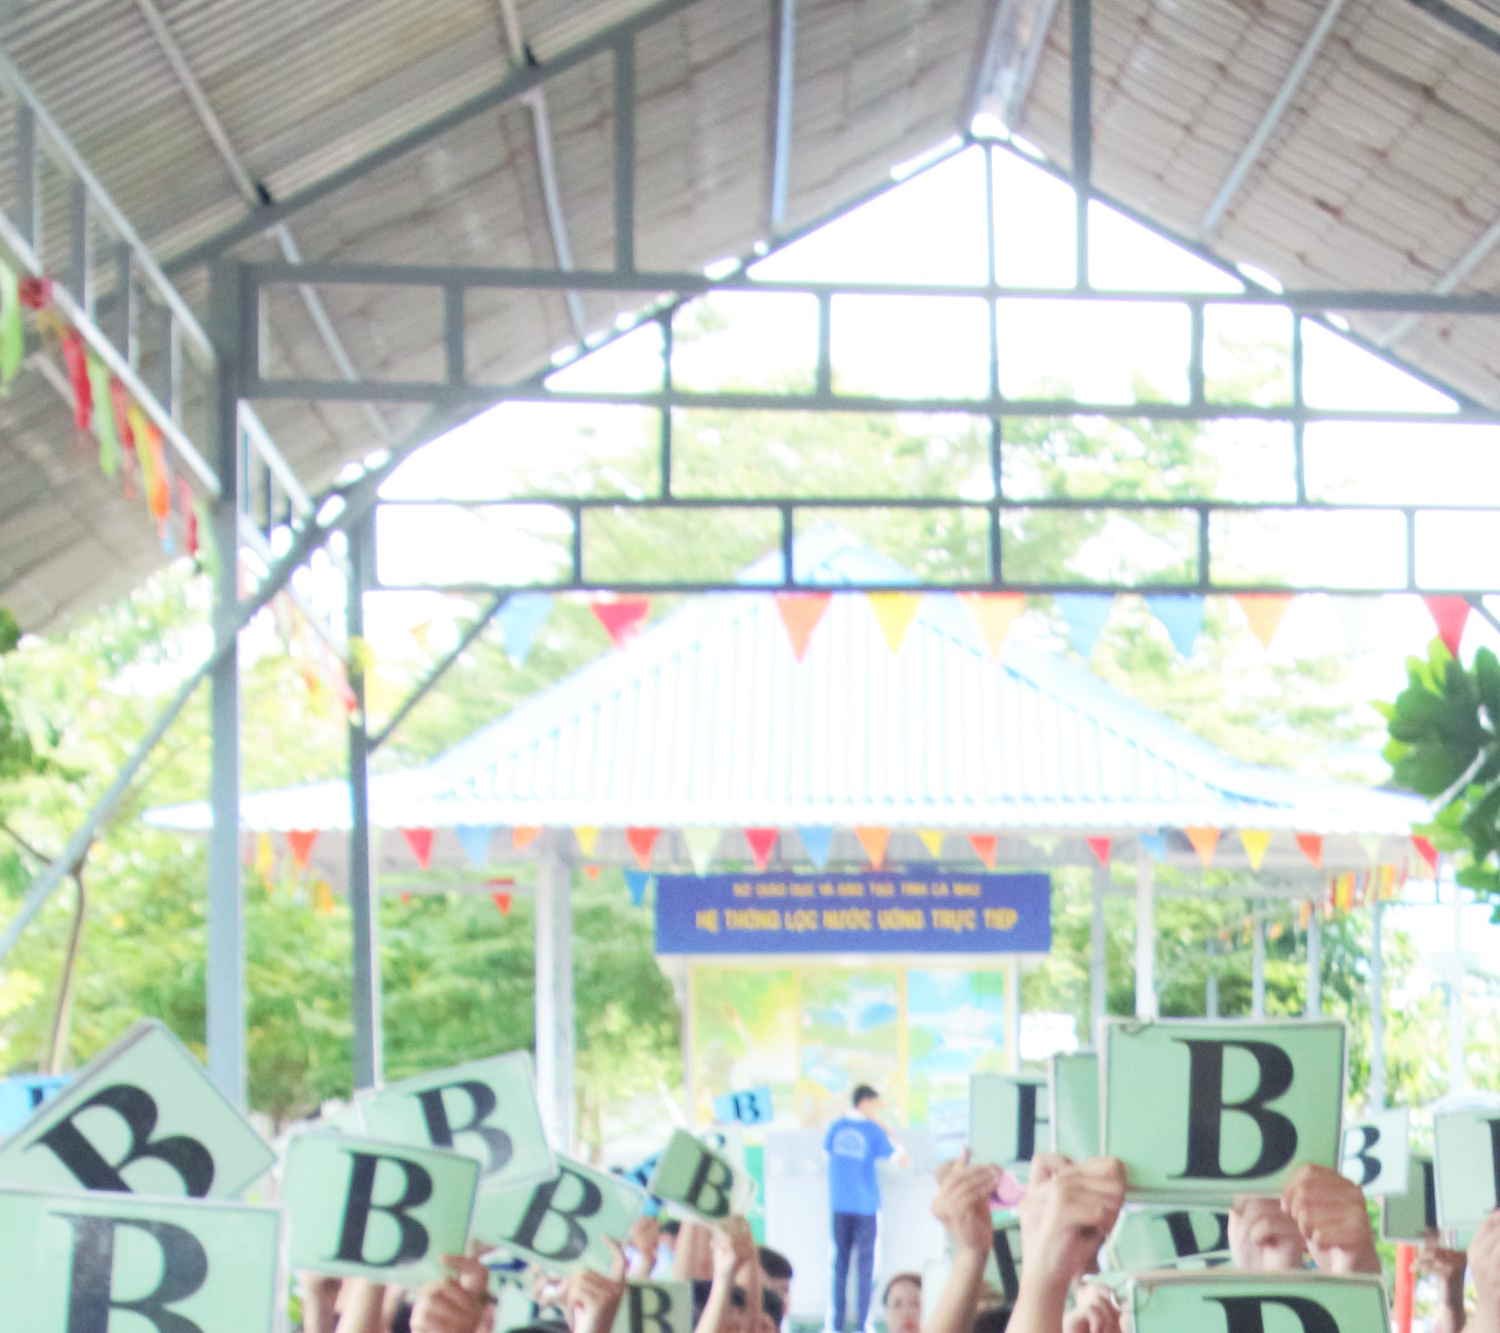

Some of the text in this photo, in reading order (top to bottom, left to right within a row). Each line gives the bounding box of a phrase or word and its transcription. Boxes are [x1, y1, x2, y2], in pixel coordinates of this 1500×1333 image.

[25, 1083, 214, 1198] B
[409, 1080, 514, 1178] B
[1167, 1037, 1298, 1180] B
[325, 1149, 433, 1267] B
[497, 1161, 602, 1263] B
[684, 1152, 733, 1219] B
